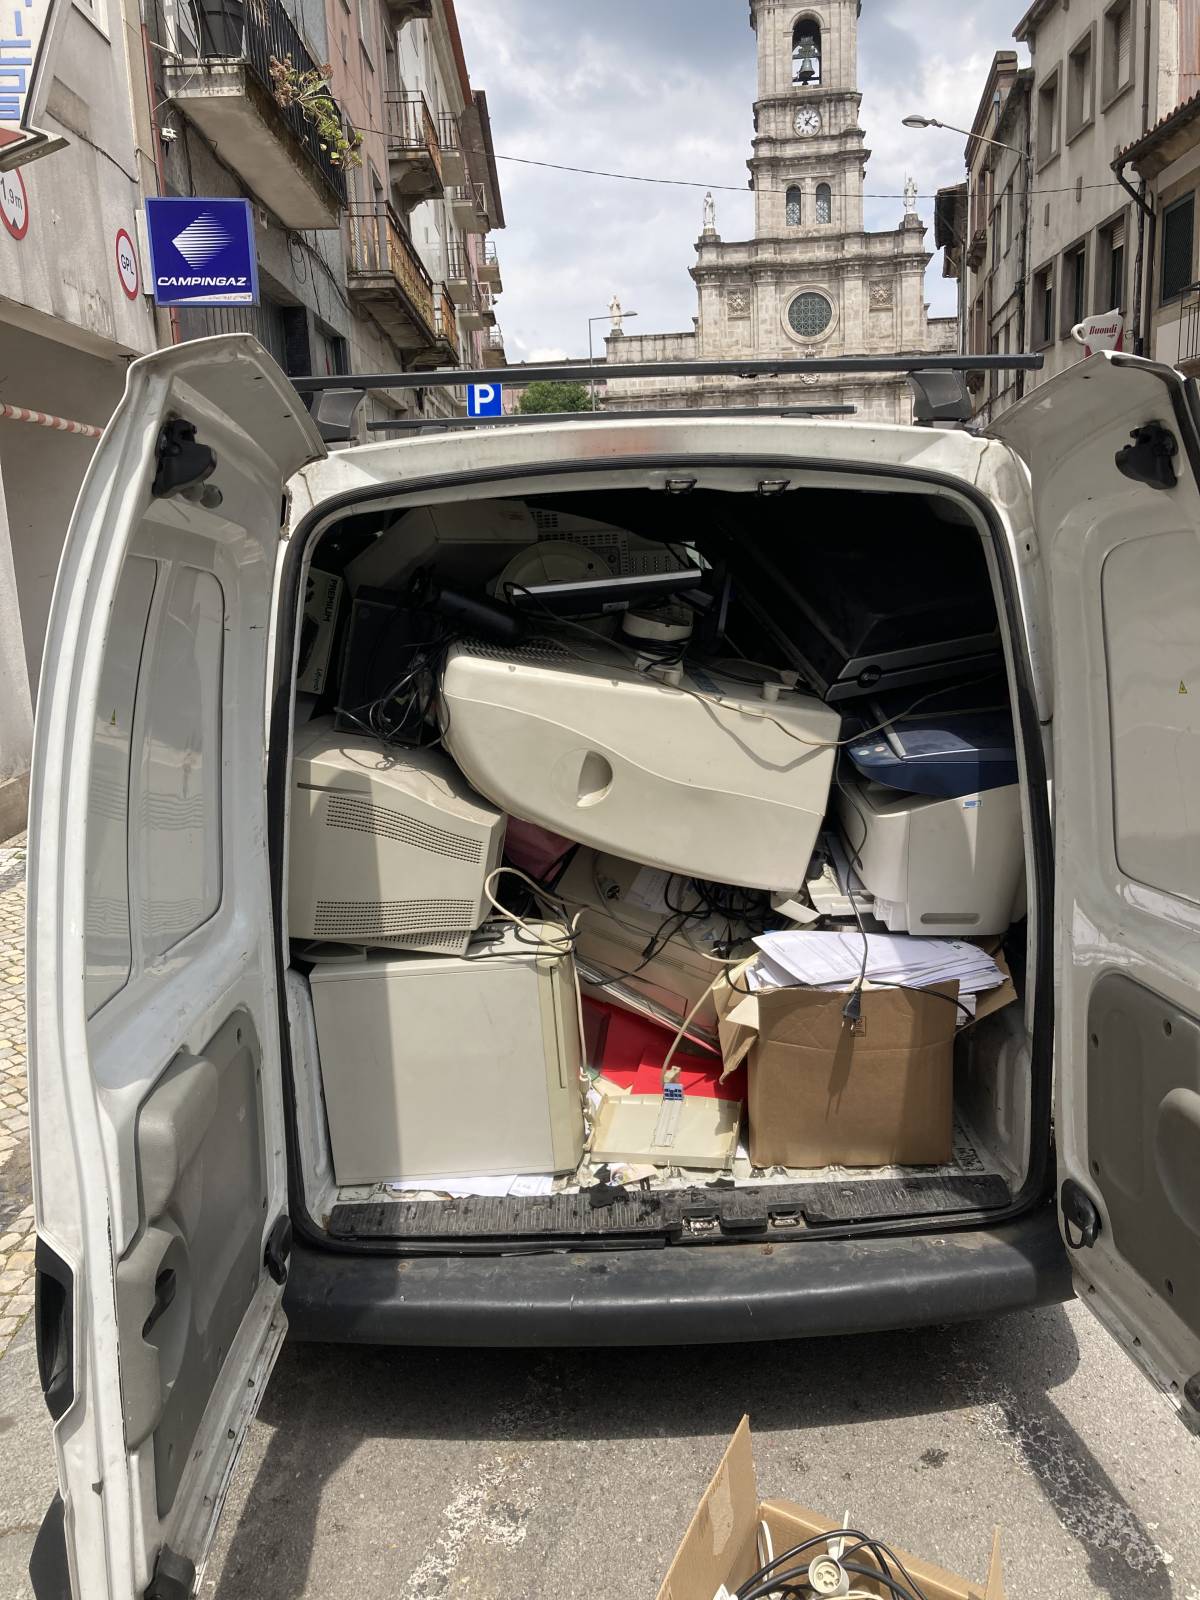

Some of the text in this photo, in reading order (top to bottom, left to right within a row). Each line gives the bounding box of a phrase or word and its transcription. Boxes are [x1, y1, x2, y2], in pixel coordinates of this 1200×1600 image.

[121, 254, 135, 275] GPL
[157, 276, 247, 286] CAMPINGAZ
[474, 384, 495, 414] P
[322, 579, 337, 622] PREMIUM
